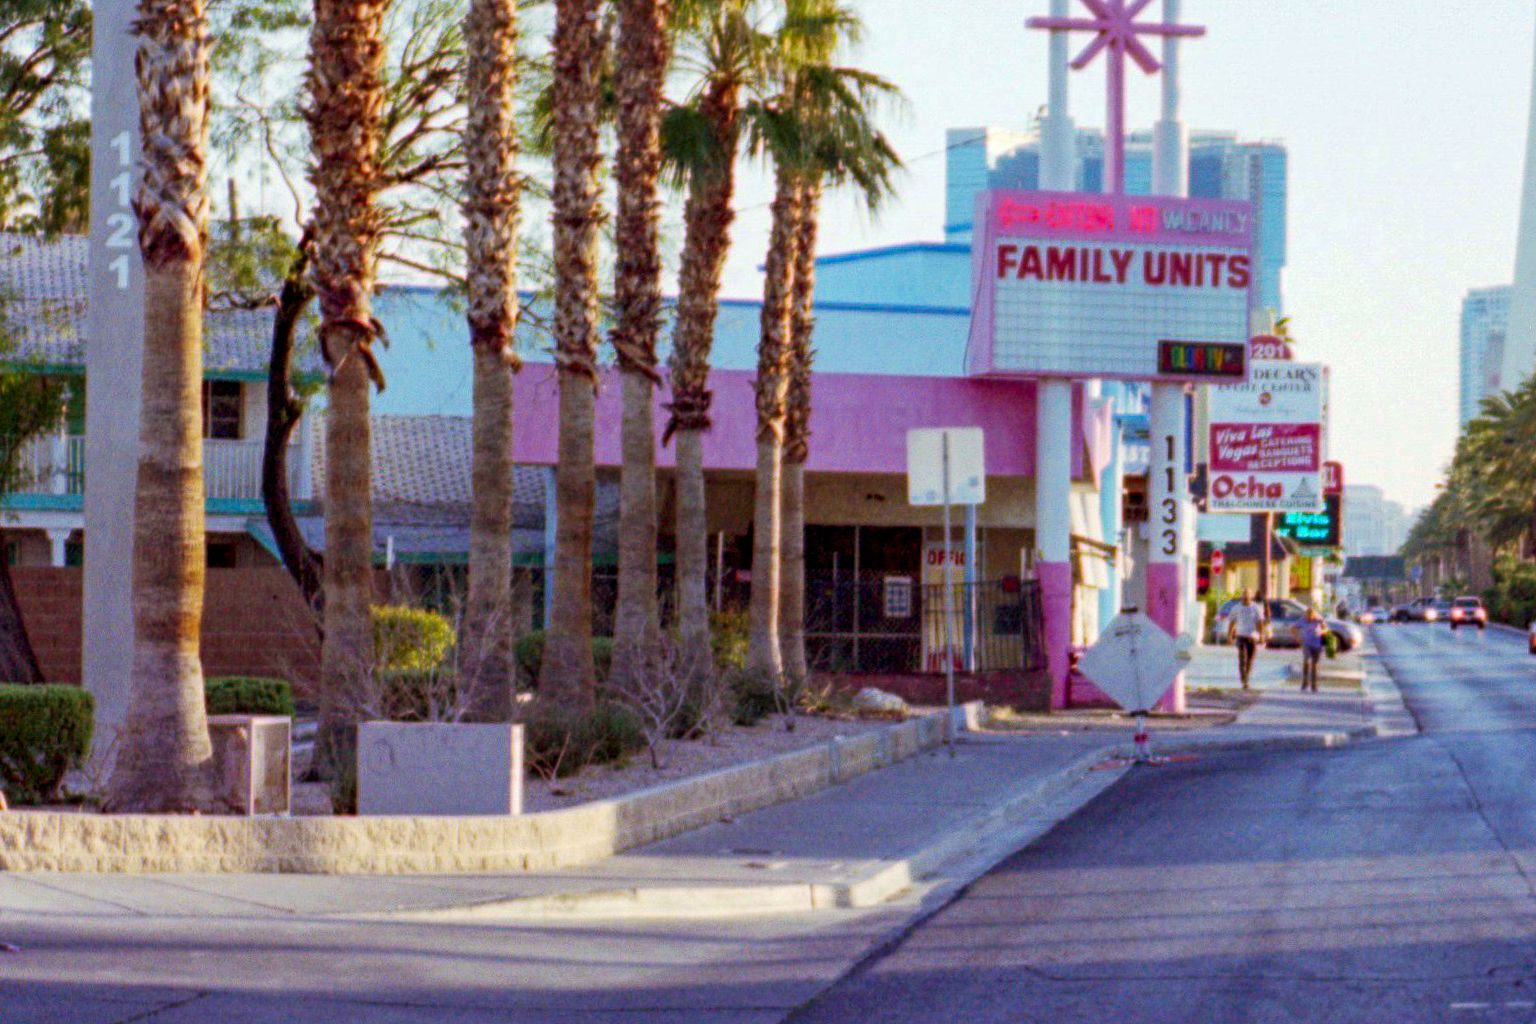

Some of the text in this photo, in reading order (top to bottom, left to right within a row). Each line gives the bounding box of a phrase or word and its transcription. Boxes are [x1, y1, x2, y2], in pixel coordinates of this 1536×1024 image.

[105, 130, 133, 289] 1121
[1163, 208, 1248, 235] VACANCY
[997, 244, 1249, 288] FAMILY UNITS
[1218, 445, 1258, 462] Vegas
[1162, 435, 1178, 556] 1133
[1212, 475, 1283, 499] Ocha
